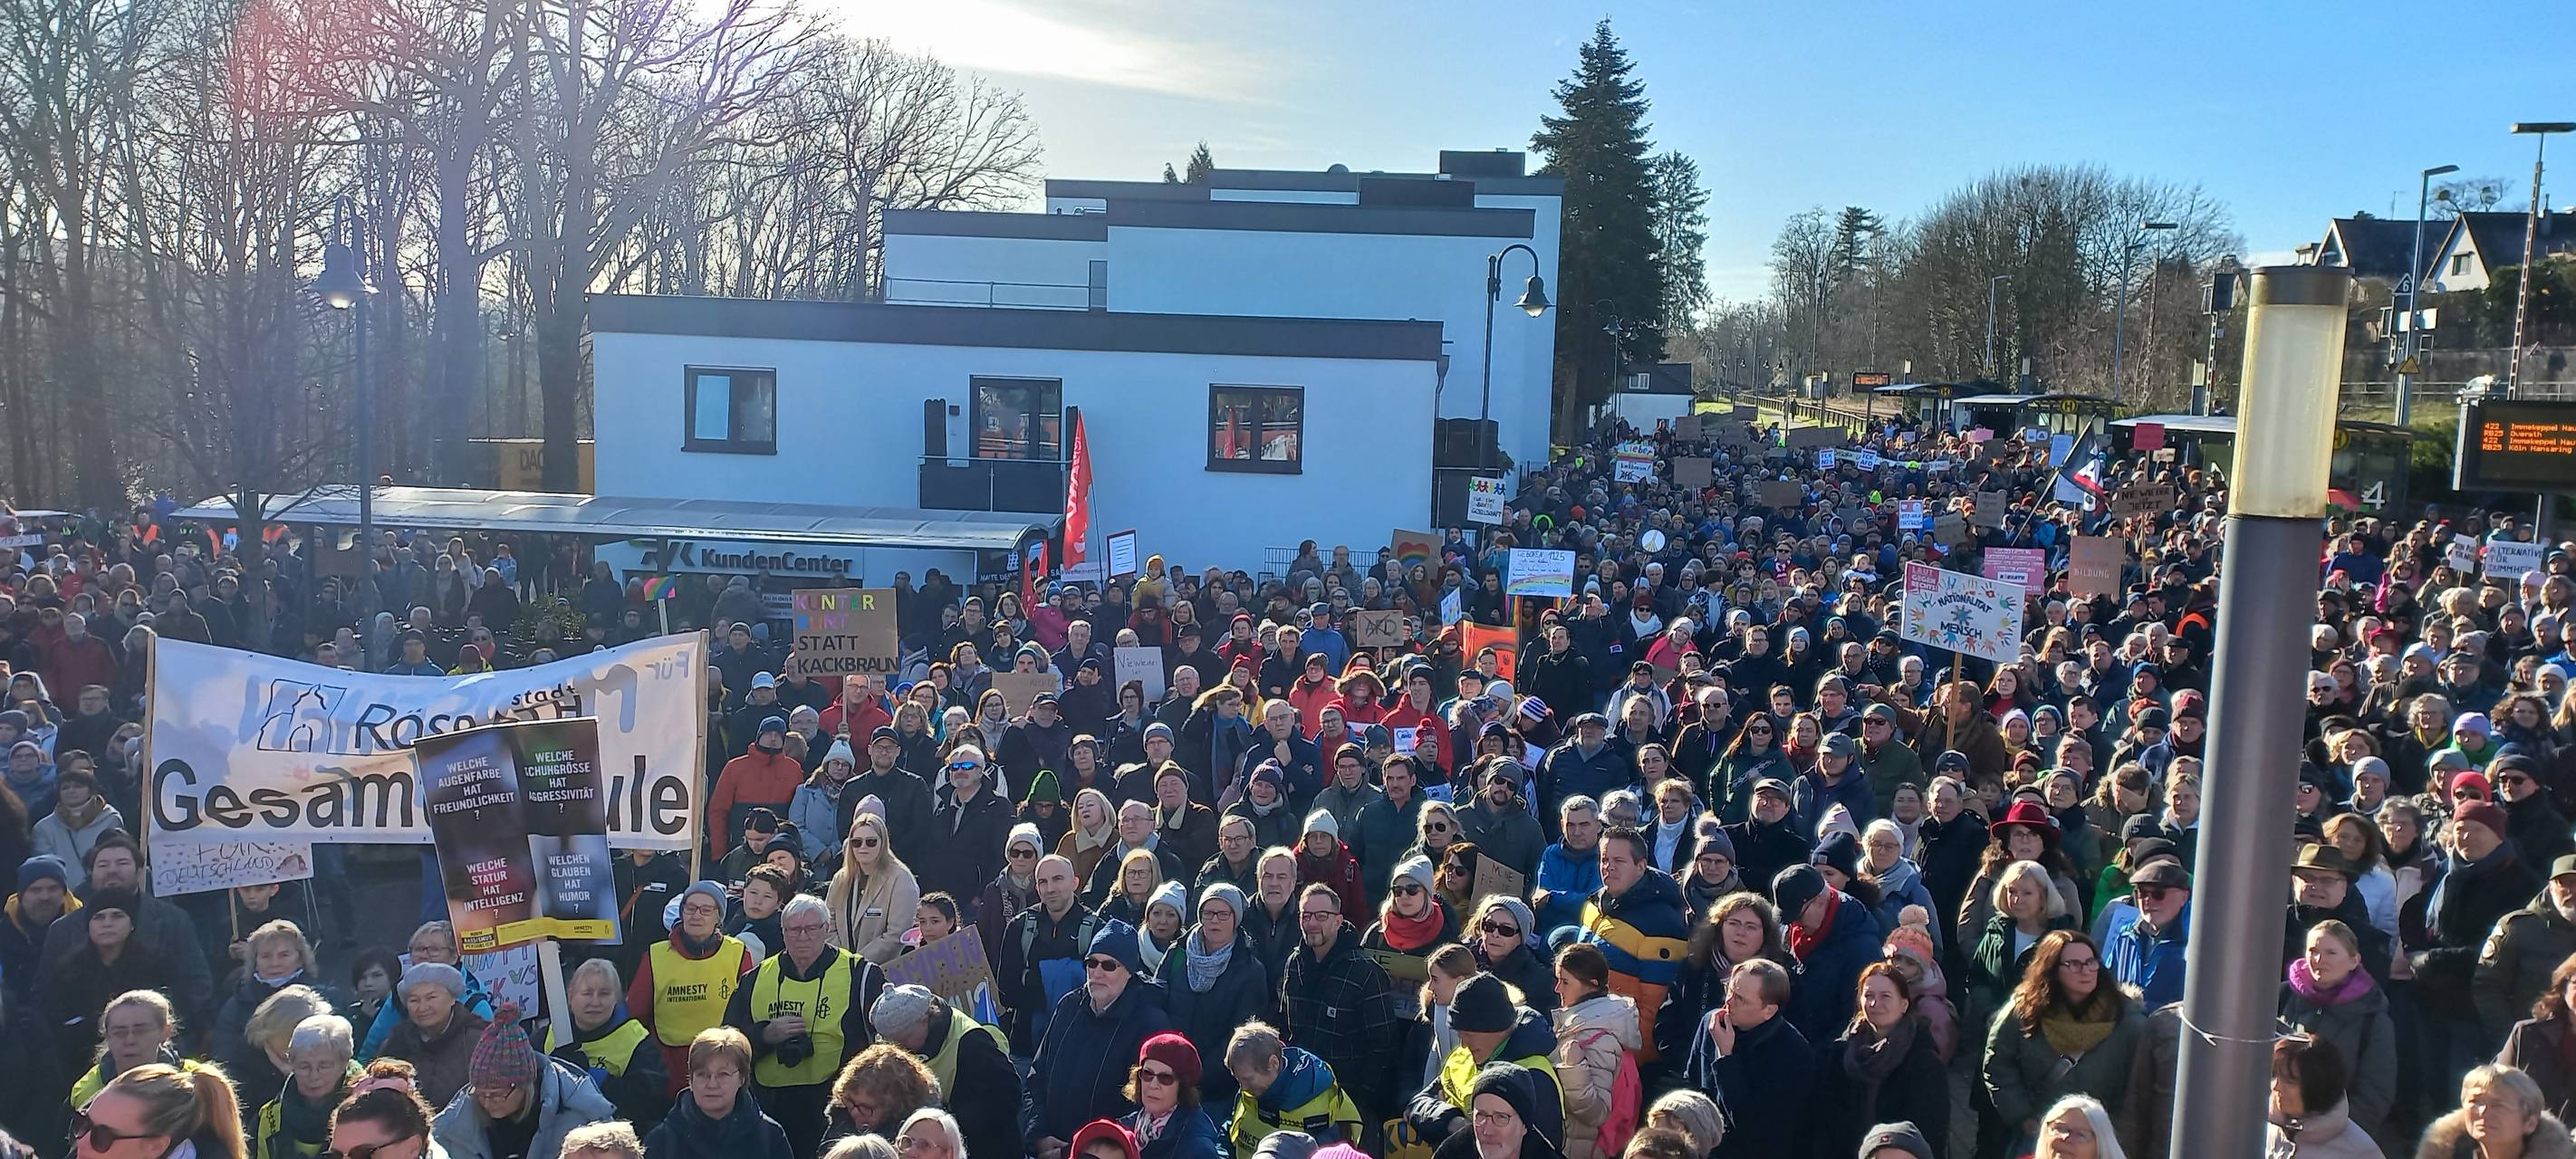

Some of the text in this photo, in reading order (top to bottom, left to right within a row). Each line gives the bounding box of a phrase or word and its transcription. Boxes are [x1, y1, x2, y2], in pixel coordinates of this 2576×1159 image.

[2403, 280, 2409, 292] 6
[2064, 401, 2073, 412] H
[2511, 424, 2558, 432] Immekeppel
[2509, 438, 2557, 446] Immekeppel
[2361, 481, 2386, 510] 4
[701, 549, 853, 574] KundenCenter
[796, 594, 876, 610] KUNTER
[1940, 620, 1982, 640] MENSCH
[798, 635, 859, 651] STATT
[797, 656, 899, 675] KACKBRAUN
[512, 684, 575, 705] stadt
[535, 750, 574, 762] WELCHE
[447, 757, 488, 773] WELCHE
[438, 769, 501, 789] AUGENFARBE
[549, 777, 567, 788] HAT
[463, 784, 483, 797] HAT
[433, 792, 515, 815] FREUNDLICHKEIT
[558, 803, 564, 814] ?
[475, 810, 481, 820] ?
[466, 858, 507, 874] WELCHE
[548, 855, 591, 866] WELCHEN
[551, 867, 591, 877] GLAUBEN
[472, 872, 508, 886] STATUR
[564, 879, 582, 890] HAT
[483, 885, 501, 896] HAT
[559, 891, 591, 902] HUMOR
[463, 893, 524, 912] INTELLIGENZ
[493, 909, 499, 919] ?
[573, 904, 580, 914] ?
[667, 983, 708, 996] AMNESTY
[767, 1001, 805, 1013] AMNESTY
